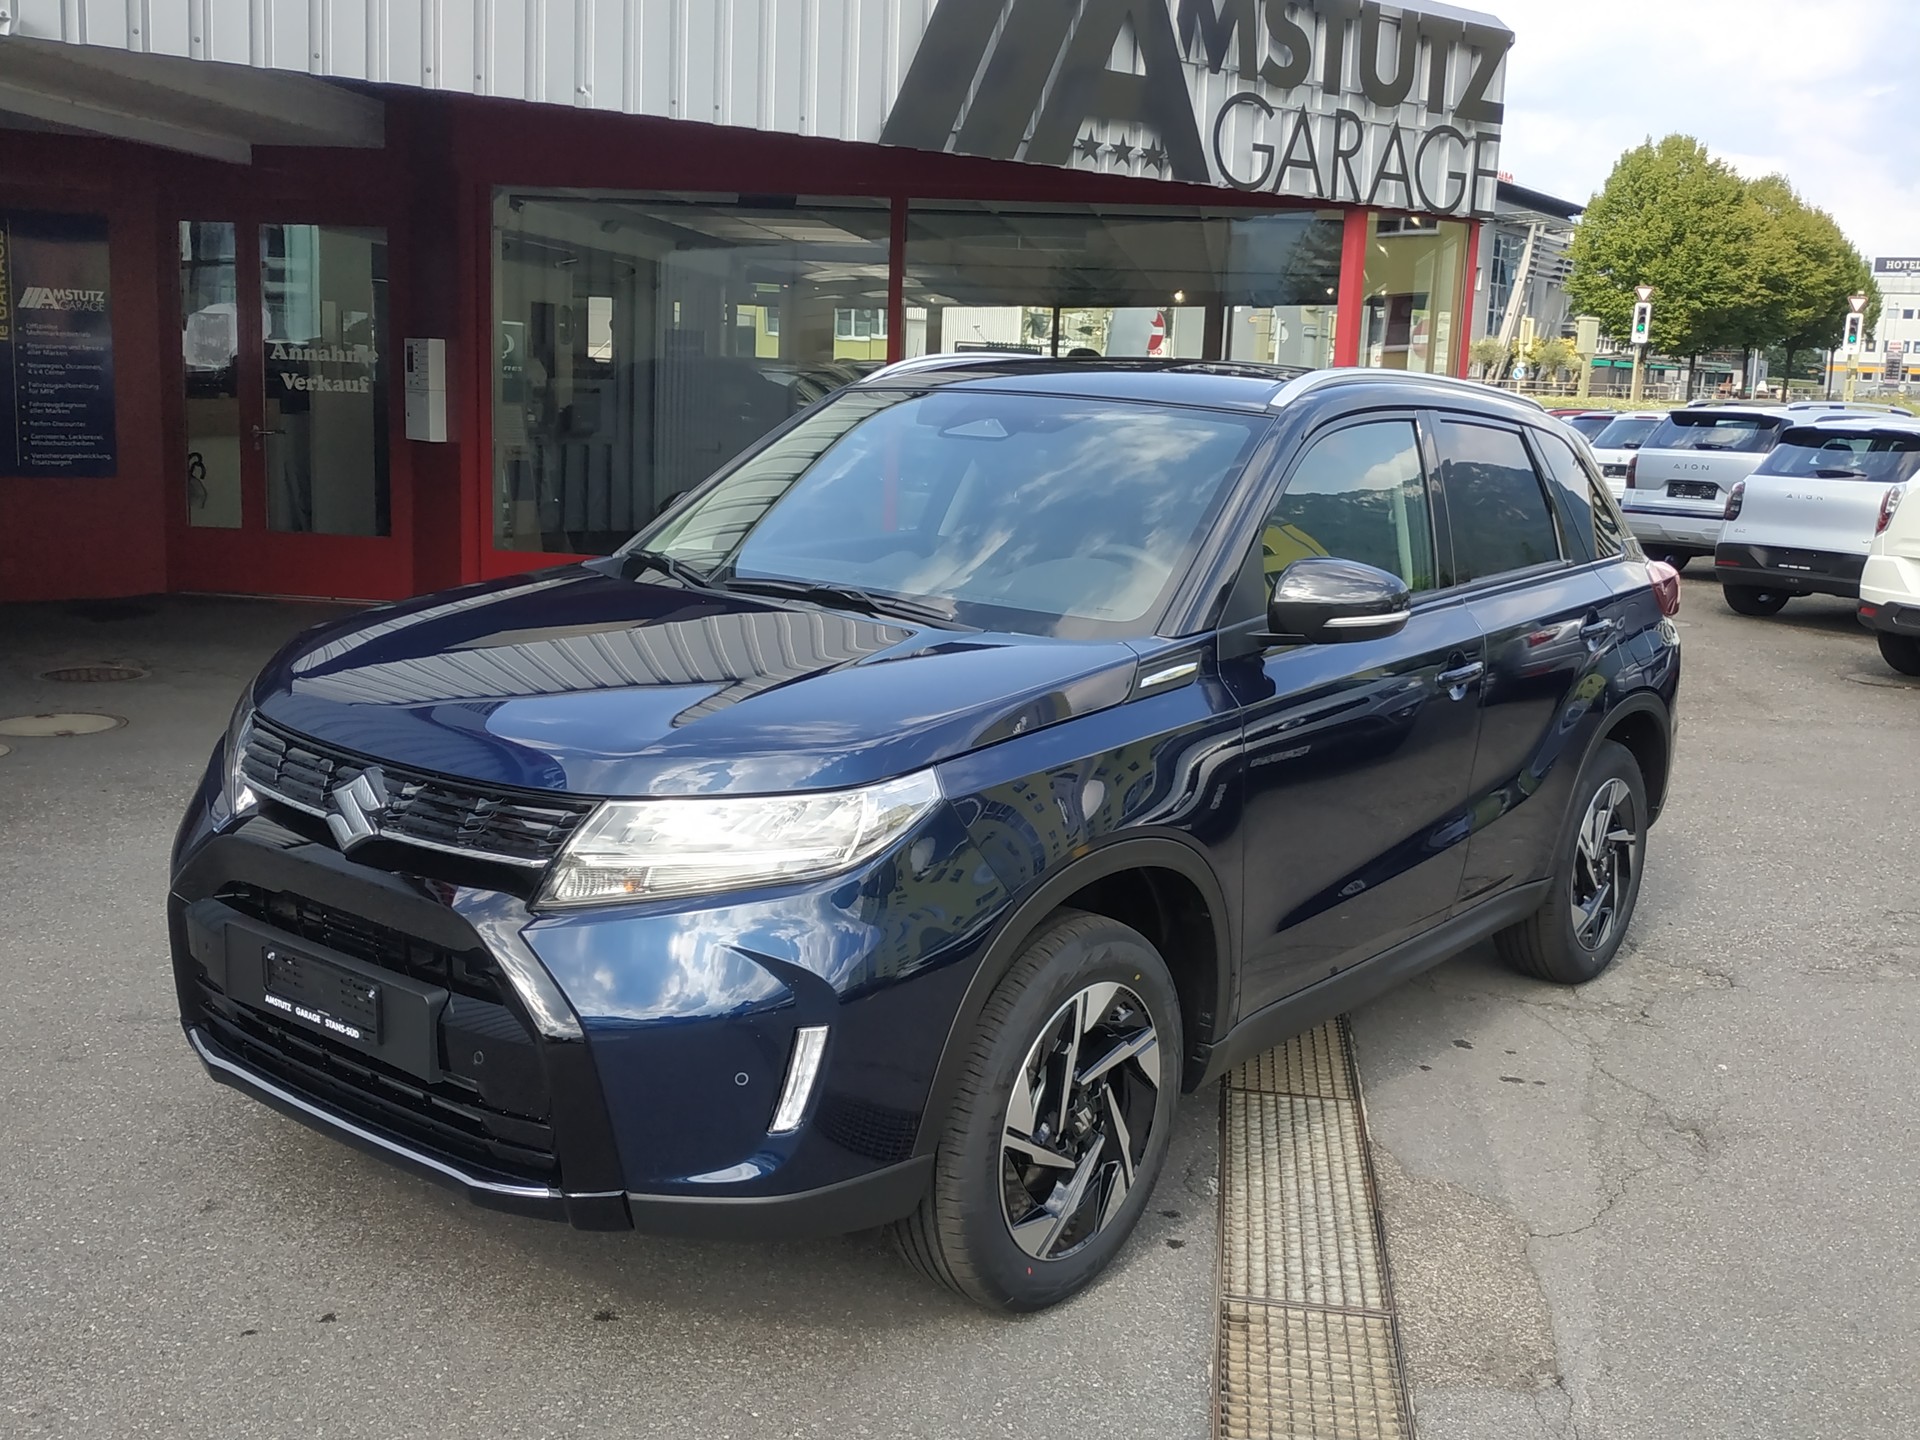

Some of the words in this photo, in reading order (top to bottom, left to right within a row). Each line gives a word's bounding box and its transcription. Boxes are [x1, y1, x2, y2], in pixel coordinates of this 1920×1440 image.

[1012, 0, 1515, 184] AMSTUTZ
[1212, 91, 1502, 218] GARAGE
[1885, 260, 1920, 270] HOTEL
[32, 286, 104, 309] AMSTUTZ
[58, 300, 105, 312] GARAGE
[280, 372, 370, 393] Verkauf
[1673, 463, 1710, 471] AION
[265, 994, 292, 1012] AMSTUTZ
[295, 1006, 321, 1024] GARAGE
[325, 1018, 360, 1039] STANS-SÜD
